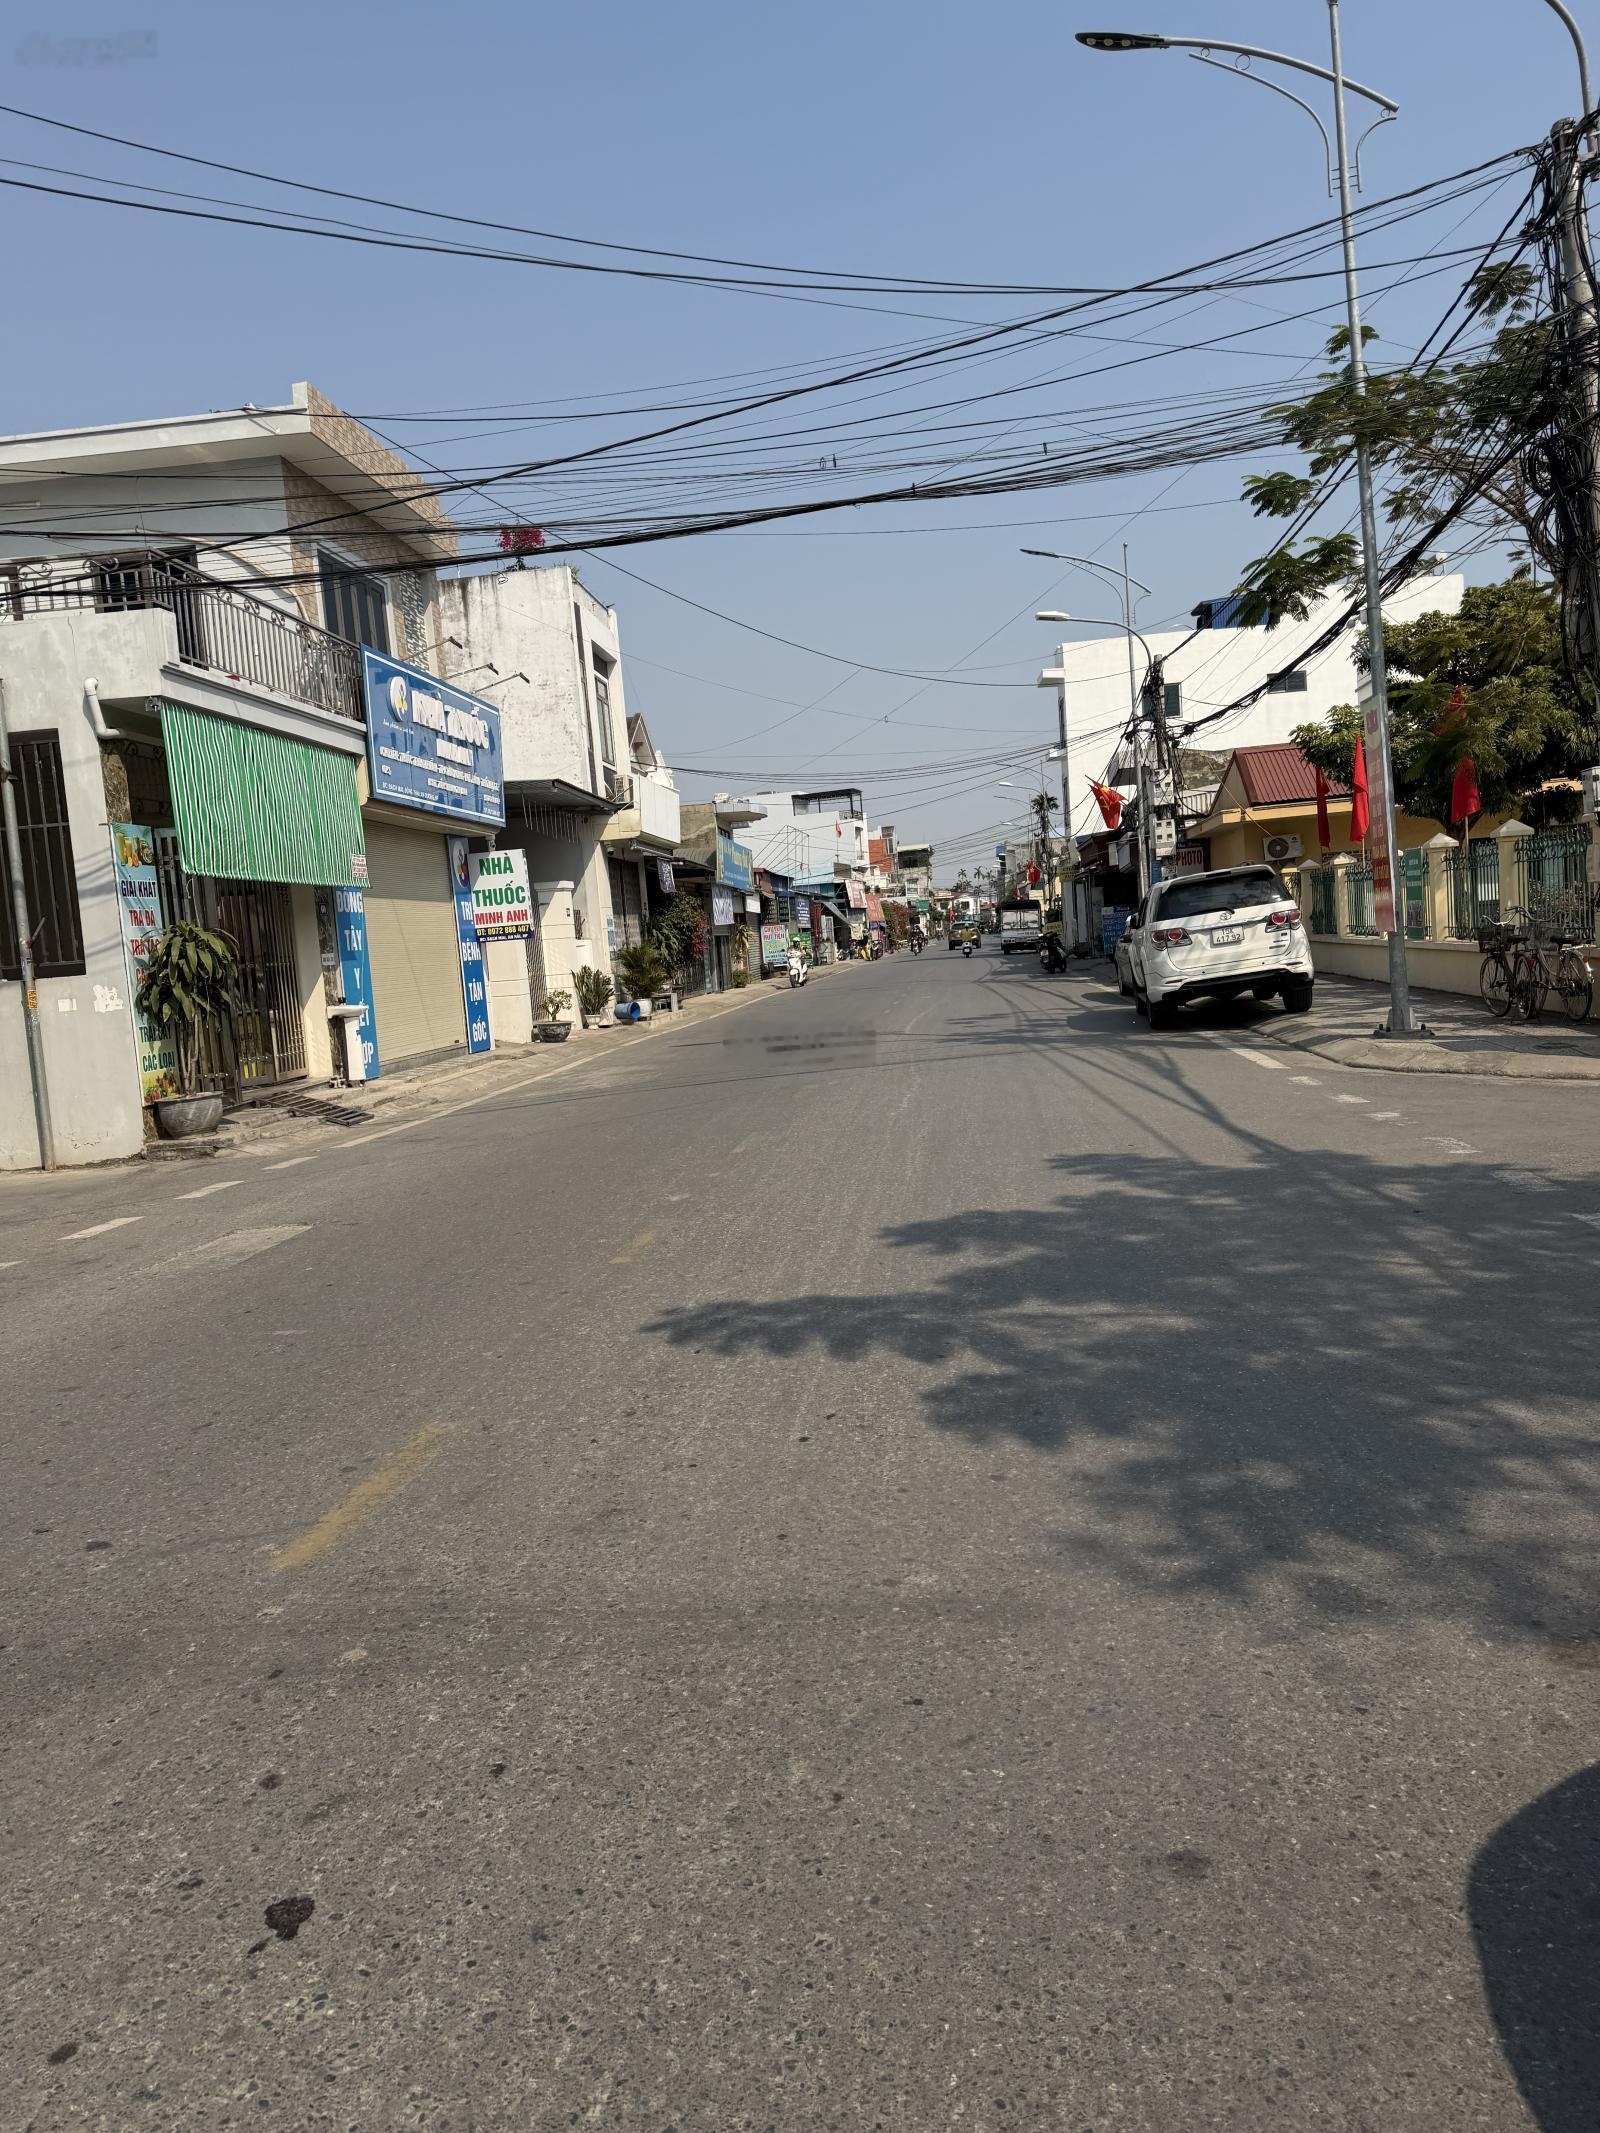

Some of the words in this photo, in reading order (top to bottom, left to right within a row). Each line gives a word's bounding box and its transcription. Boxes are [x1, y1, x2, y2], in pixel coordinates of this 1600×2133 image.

[411, 690, 446, 733] NHÀ
[444, 706, 489, 749] THUỐC
[478, 852, 514, 876] NHÀ
[1176, 849, 1203, 866] PHOTO
[121, 875, 137, 898] GIẢI
[138, 878, 157, 898] KHÁT
[473, 880, 526, 907] THUỐC
[335, 886, 364, 913] ĐÔNG
[129, 906, 144, 927] TRÀ
[144, 906, 156, 927] ĐÁ
[461, 900, 474, 925] TRỊ
[475, 911, 504, 926] MINH
[506, 909, 529, 923] ANH
[344, 924, 362, 951] TÂY
[487, 926, 504, 935] 0972
[517, 924, 530, 933] 407
[461, 939, 482, 966] BỆNH
[353, 967, 361, 990] Y
[468, 978, 483, 1006] TẬN
[472, 1015, 487, 1042] GỐC
[142, 1051, 158, 1073] CÁC
[158, 1050, 176, 1073] LOẠI
[362, 1040, 374, 1069] ỢP
